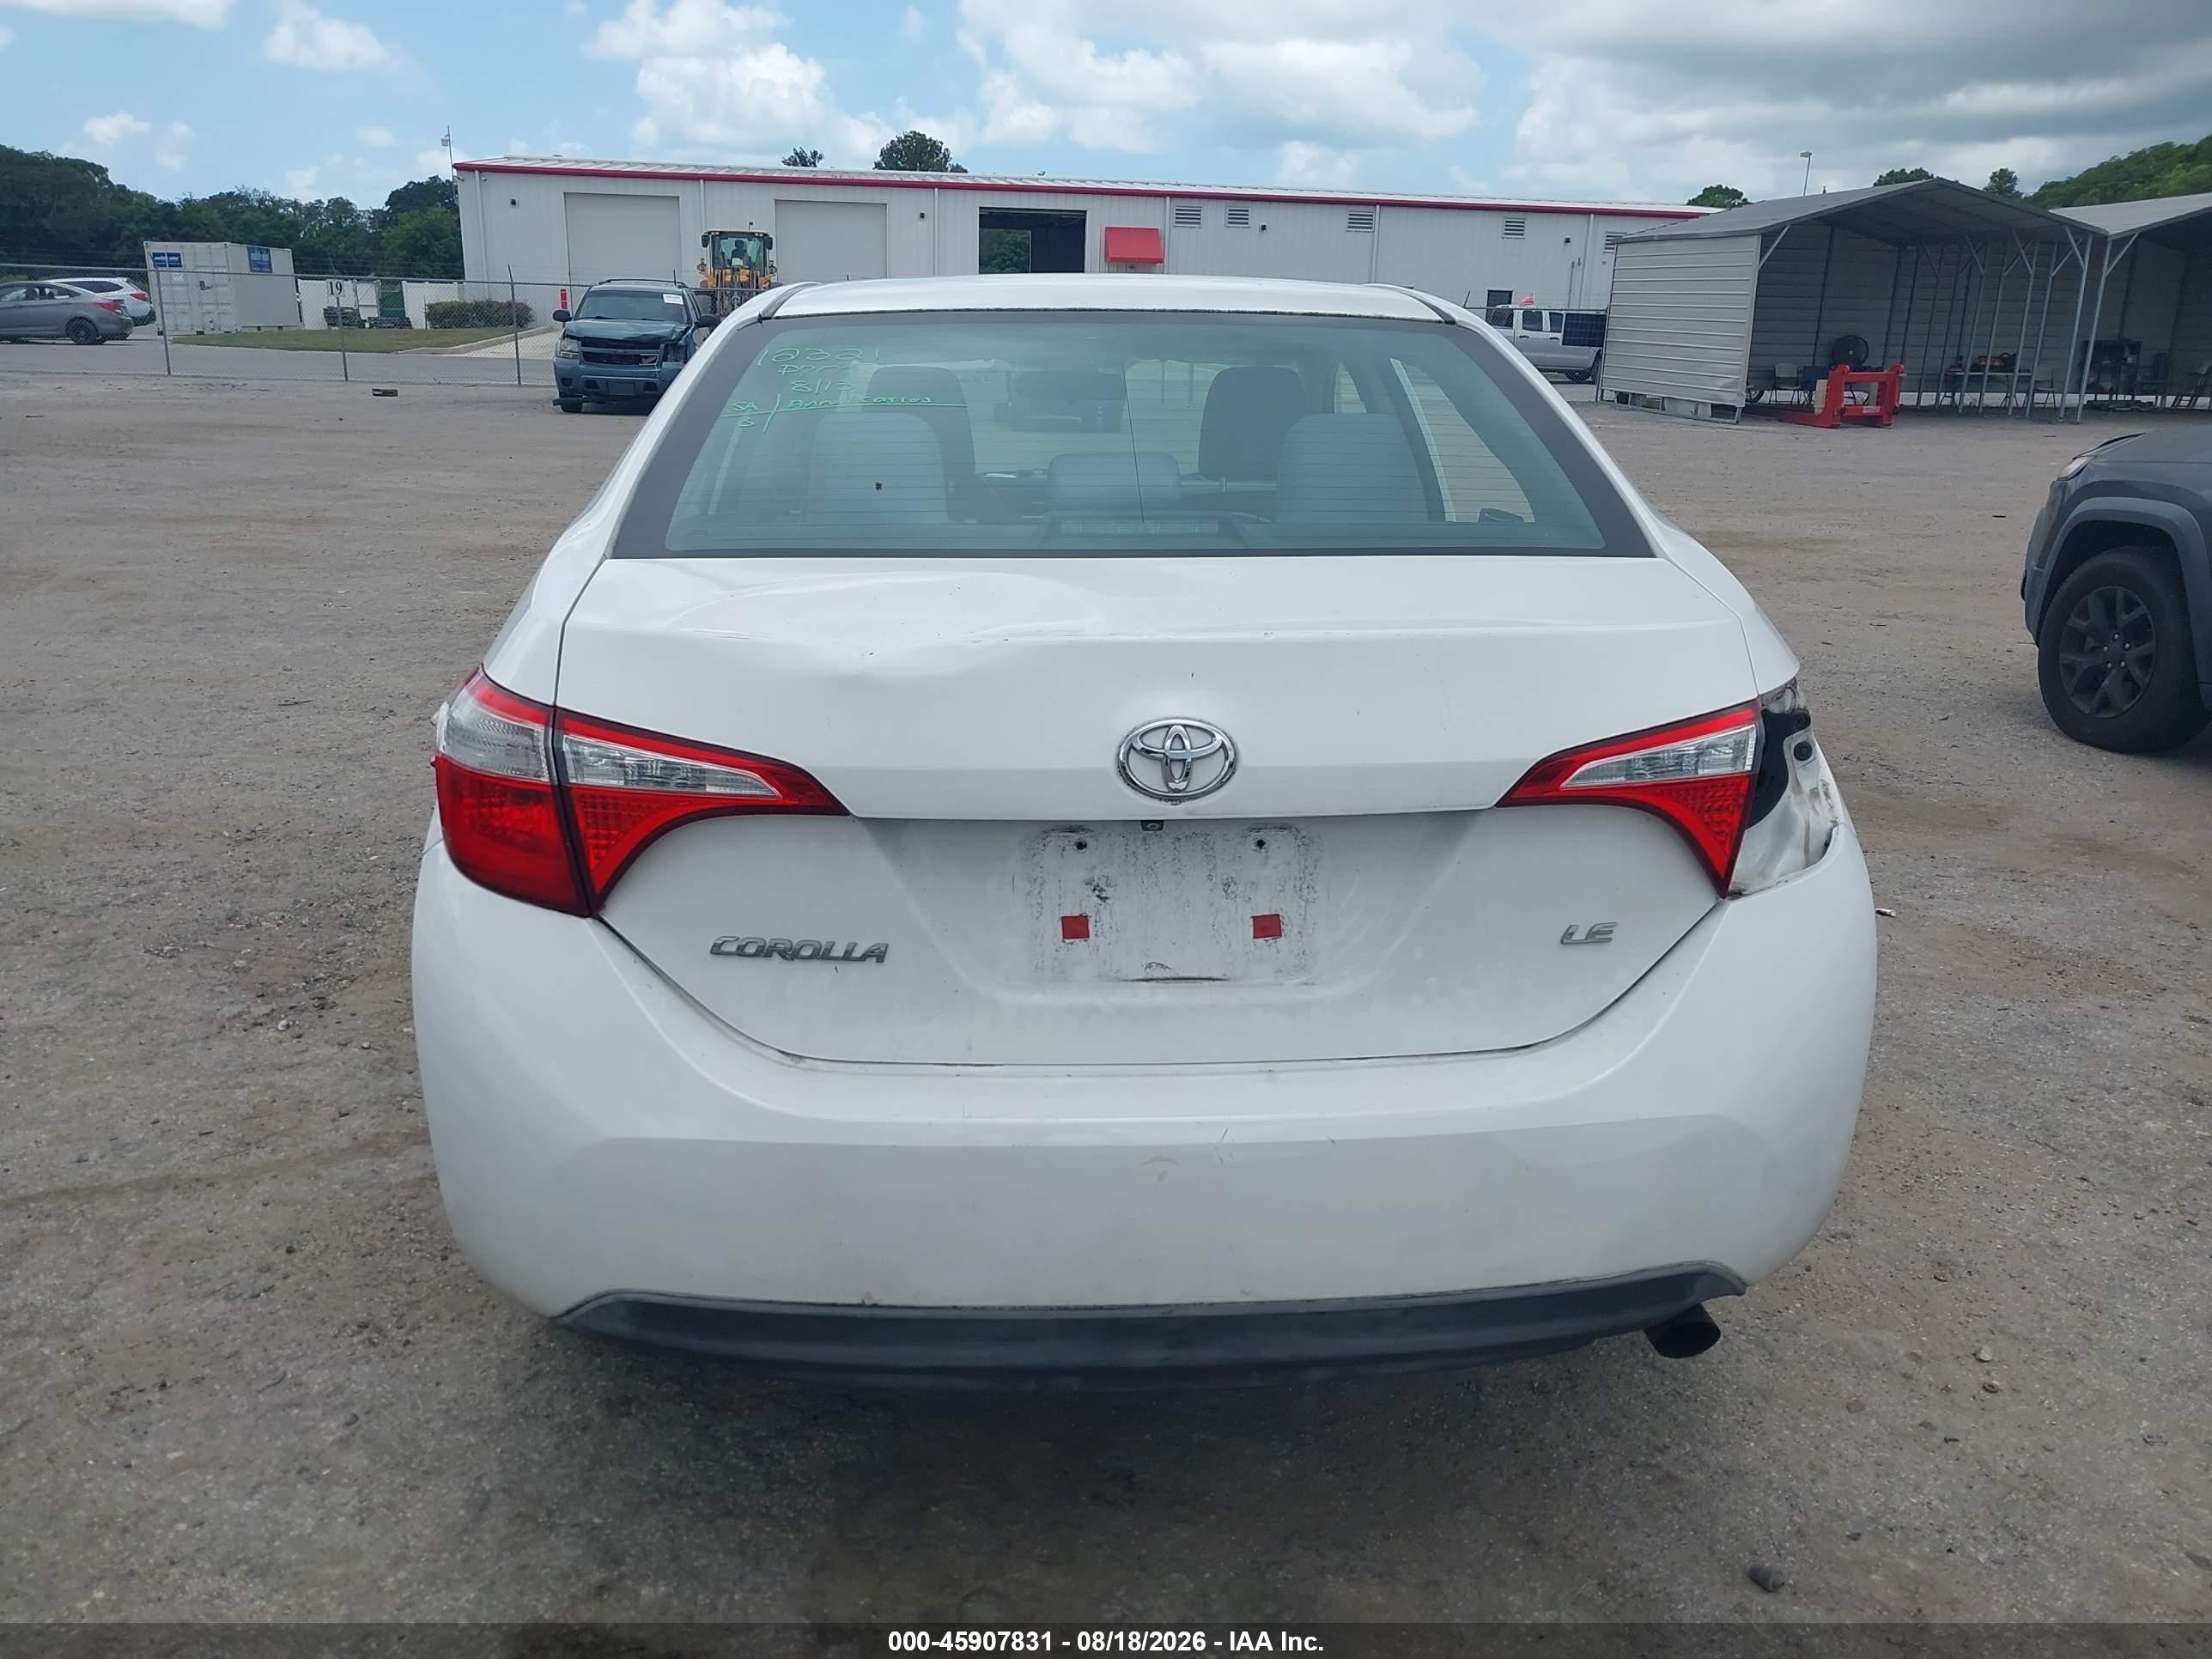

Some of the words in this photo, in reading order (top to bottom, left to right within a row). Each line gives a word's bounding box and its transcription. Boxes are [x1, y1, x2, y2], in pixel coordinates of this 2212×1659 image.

[330, 281, 343, 295] 19
[1560, 921, 1618, 945] LE
[709, 935, 890, 963] COROLLA
